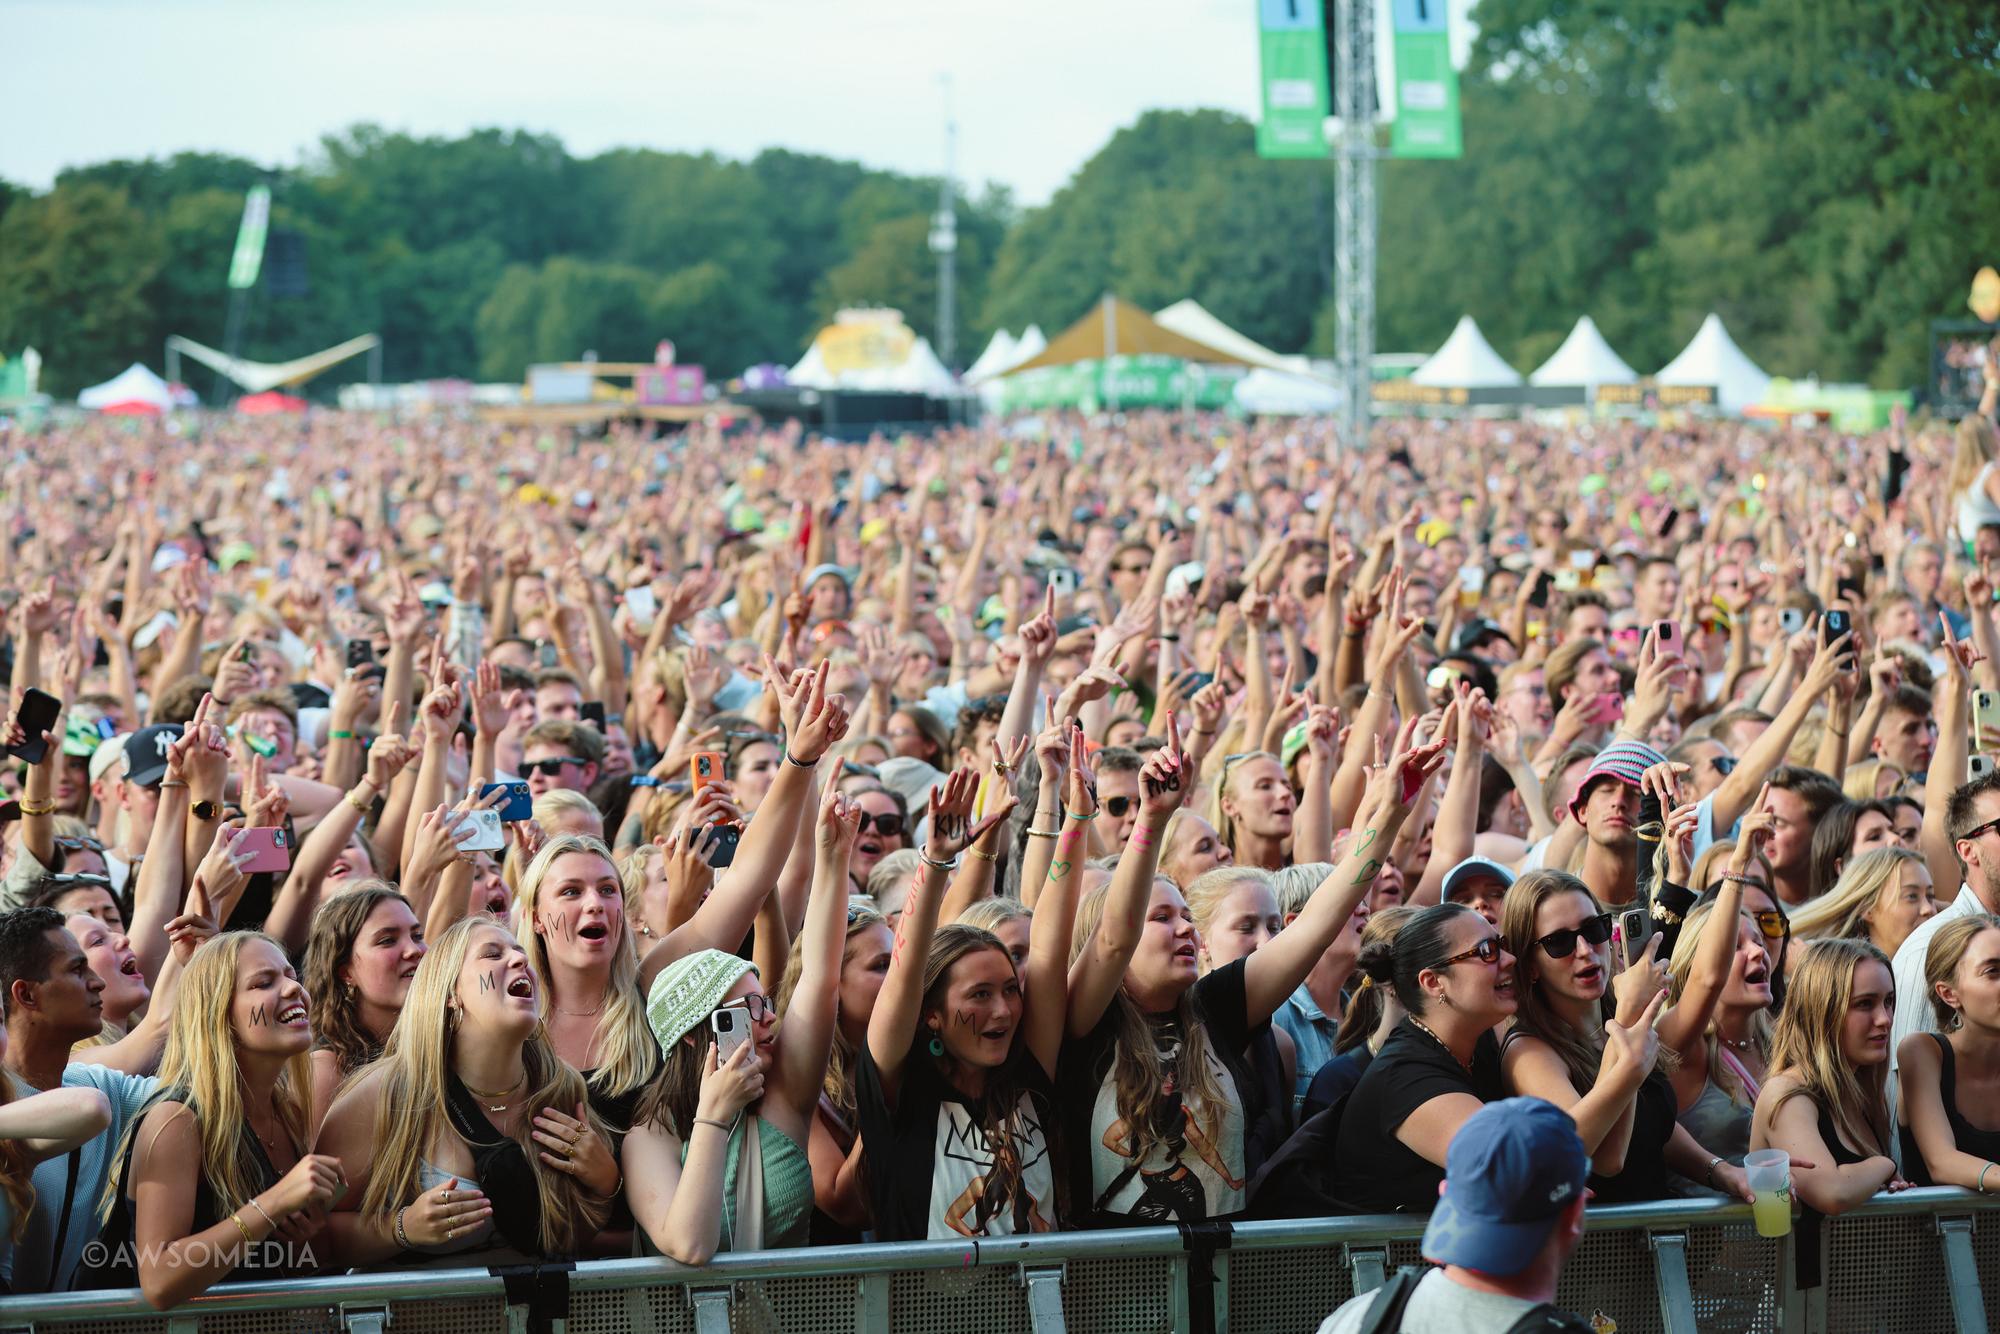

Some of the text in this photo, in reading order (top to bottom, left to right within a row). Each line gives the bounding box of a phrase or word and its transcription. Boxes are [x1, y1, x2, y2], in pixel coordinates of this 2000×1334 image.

[547, 911, 570, 943] M
[479, 969, 496, 995] M
[248, 1002, 267, 1029] M
[953, 1009, 977, 1036] M
